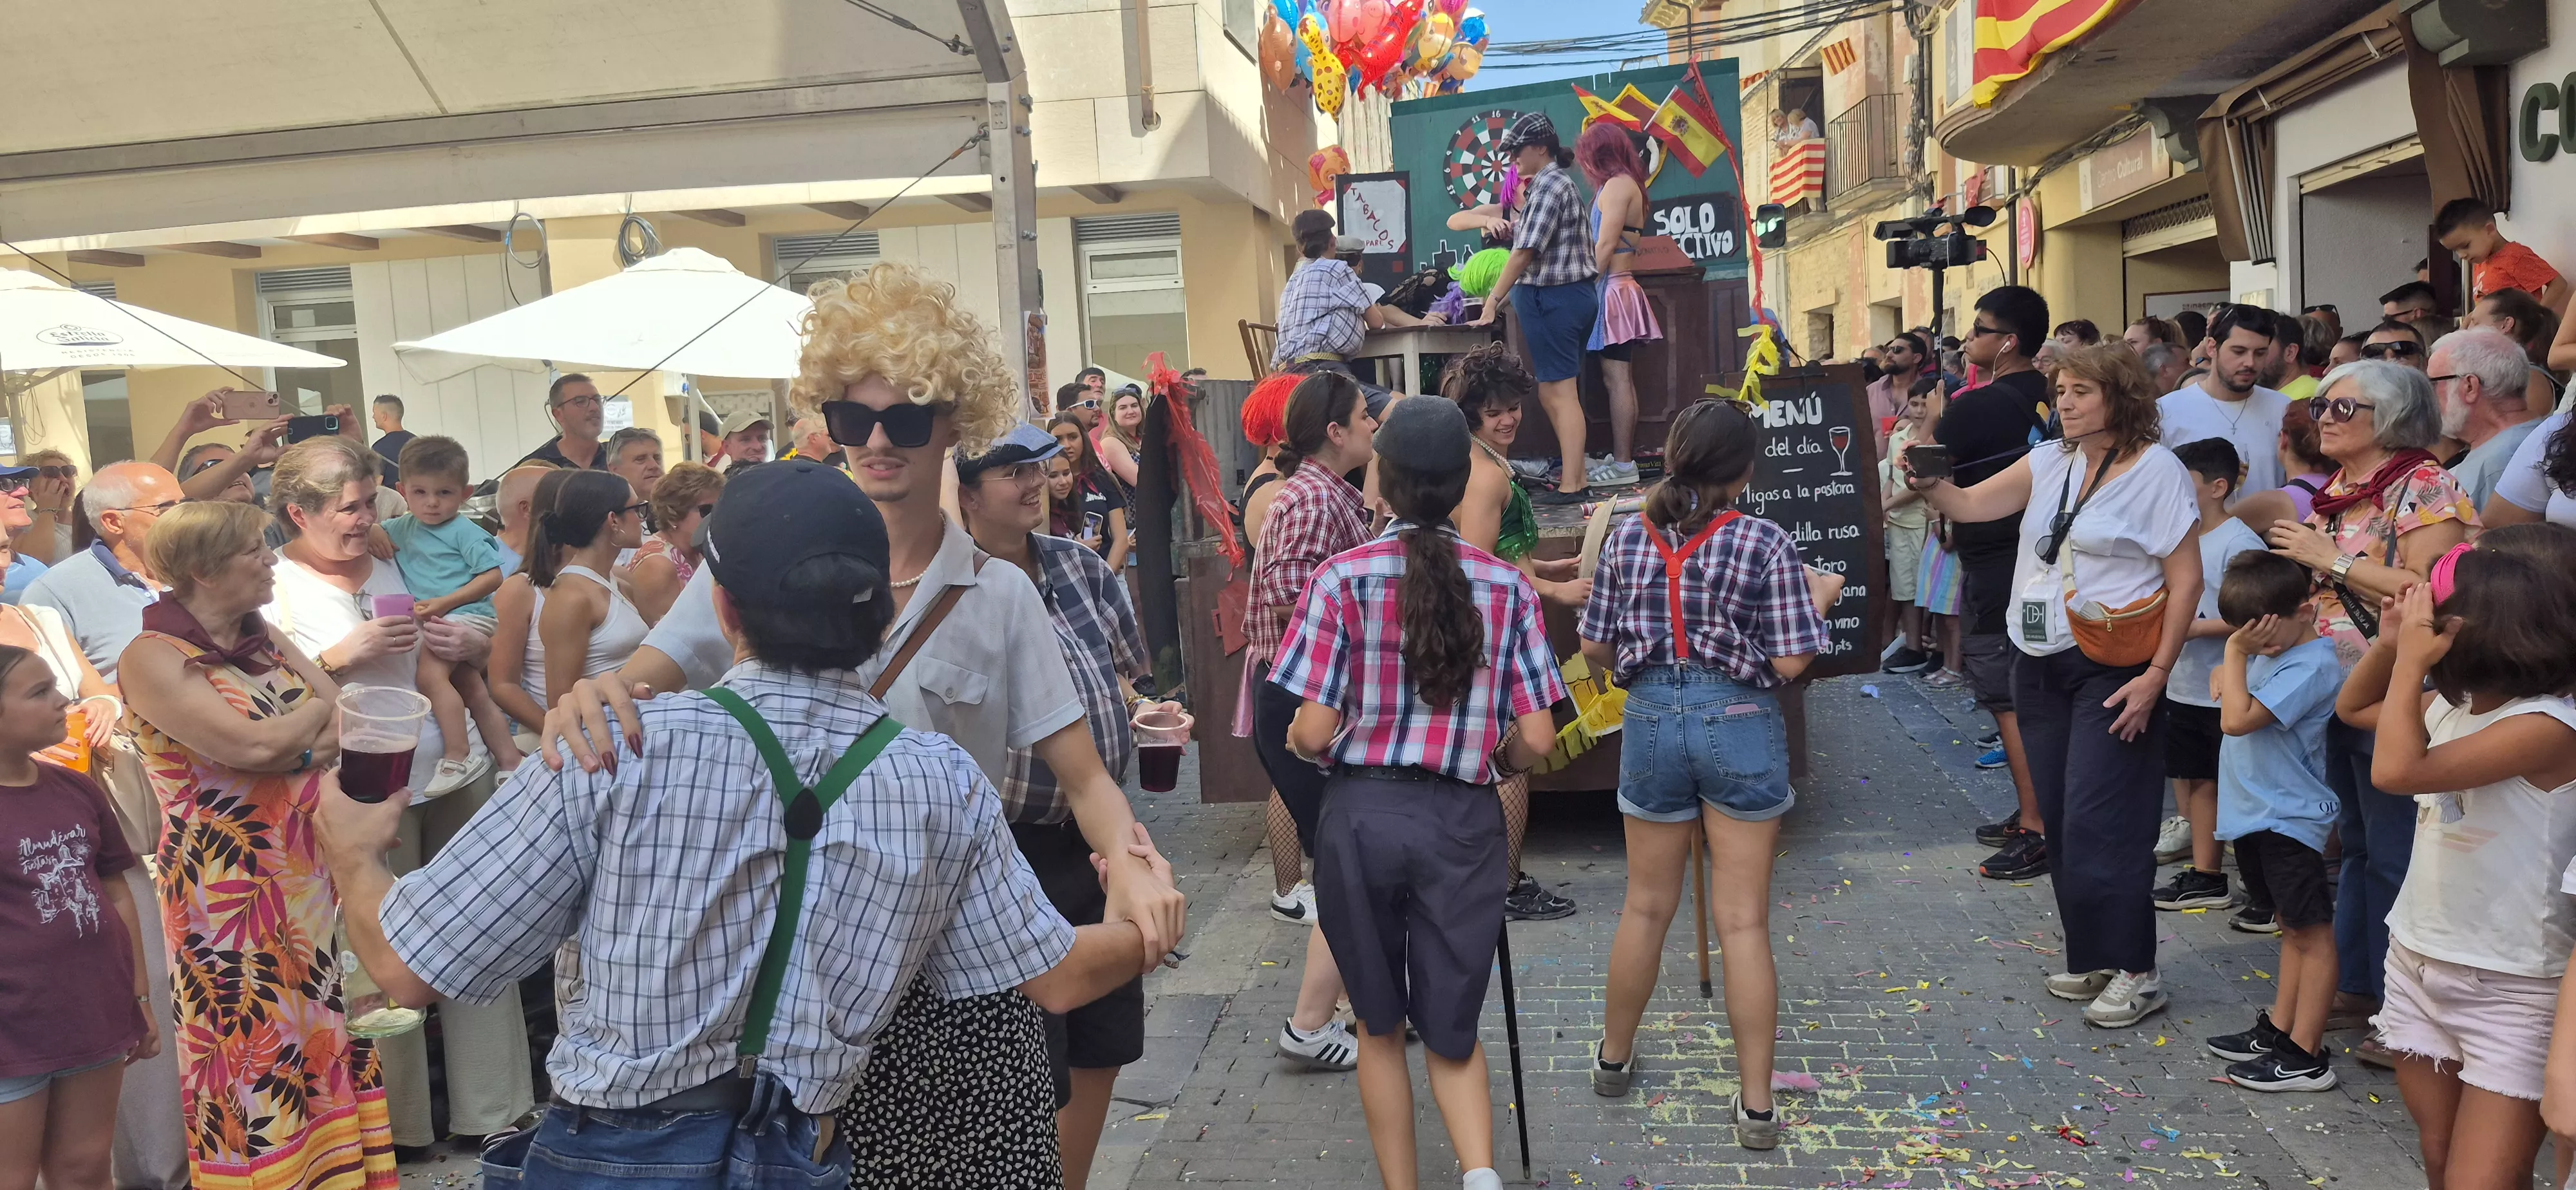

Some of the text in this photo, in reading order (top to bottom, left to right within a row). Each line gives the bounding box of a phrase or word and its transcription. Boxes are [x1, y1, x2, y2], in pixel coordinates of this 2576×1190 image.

[1472, 115, 1481, 124] 11
[2097, 149, 2143, 188] Centro Cultural
[1350, 187, 1394, 250] TABACOS
[1653, 202, 1715, 236] SOLO
[1765, 435, 1823, 457] del día
[1783, 489, 1792, 500] a
[1797, 484, 1810, 498] la
[1814, 480, 1855, 502] pastora
[1790, 521, 1861, 542] dilla rusa
[1814, 555, 1847, 572] toro
[1834, 585, 1866, 607] jana
[1835, 616, 1859, 629] vino
[1835, 638, 1852, 656] pts
[17, 823, 86, 856] Almudévar
